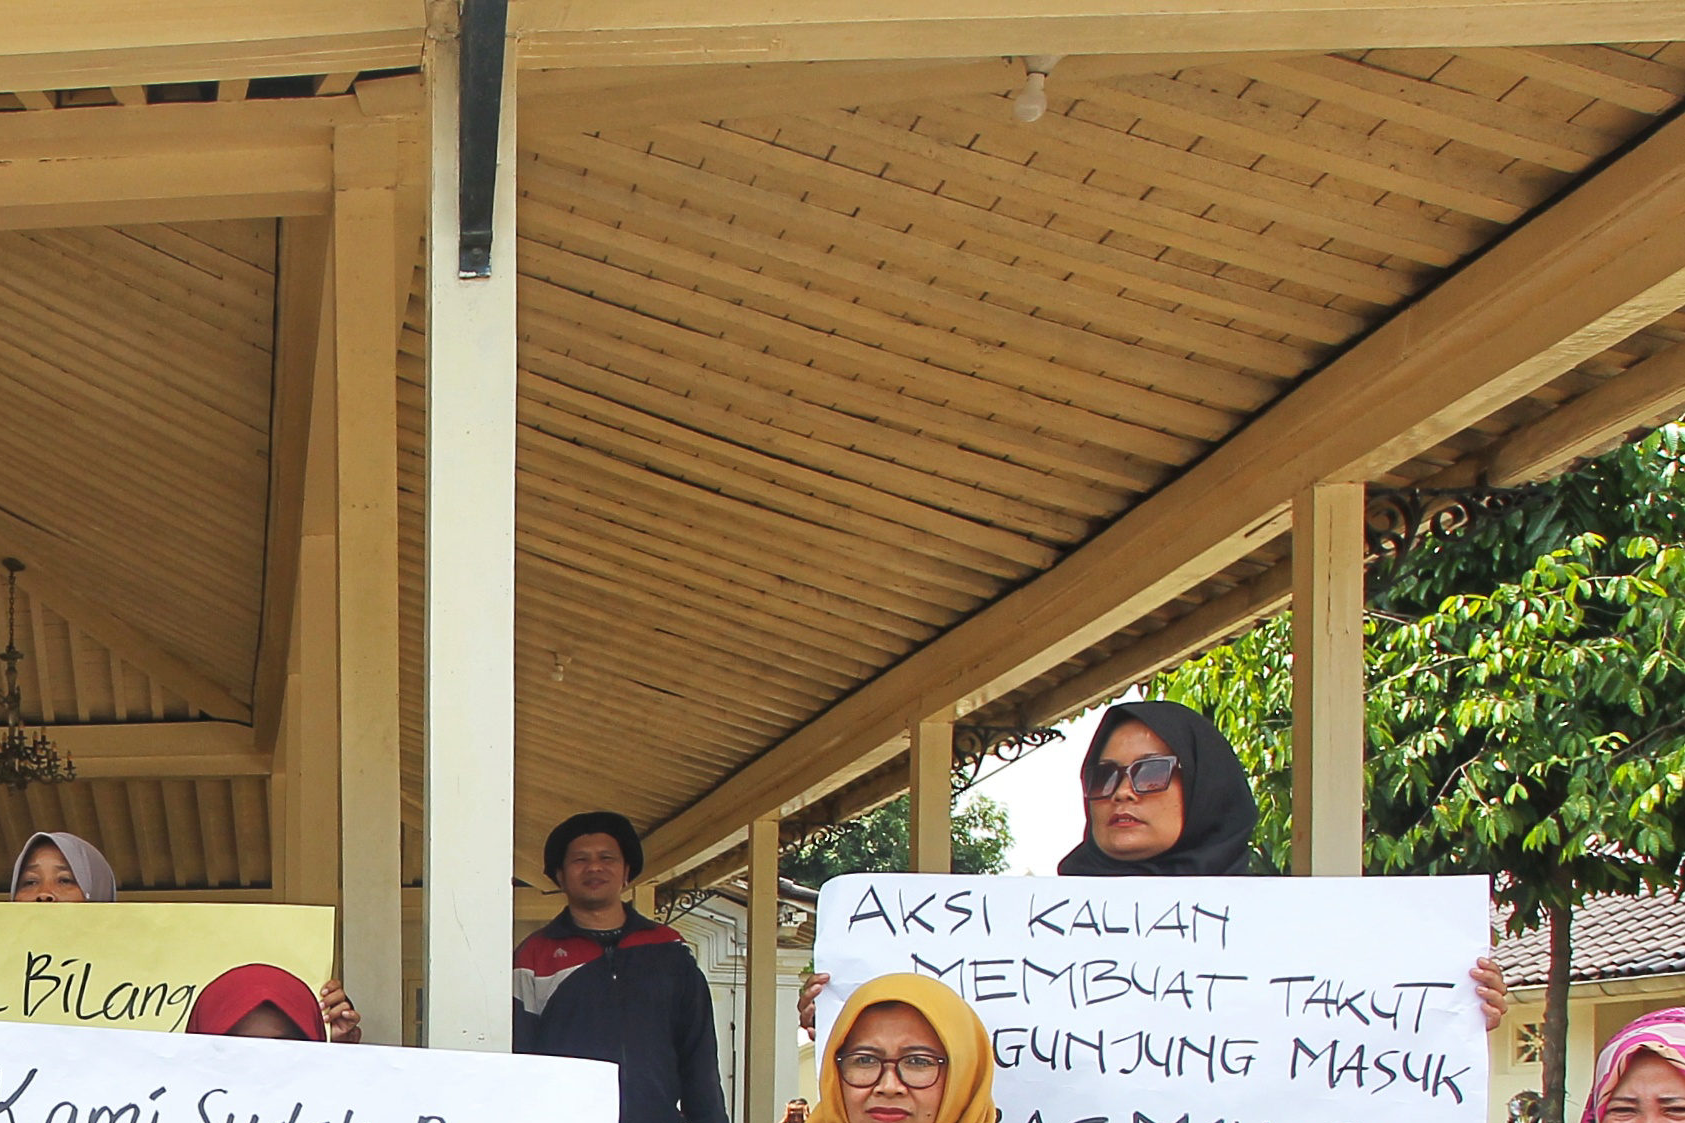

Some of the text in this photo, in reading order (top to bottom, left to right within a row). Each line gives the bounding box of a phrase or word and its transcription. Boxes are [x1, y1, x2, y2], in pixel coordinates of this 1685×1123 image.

[848, 885, 1231, 951] AKSI KALIAN
[910, 953, 1456, 1033] MEMBUAT TAKUT
[1289, 1036, 1471, 1105] MASUK
